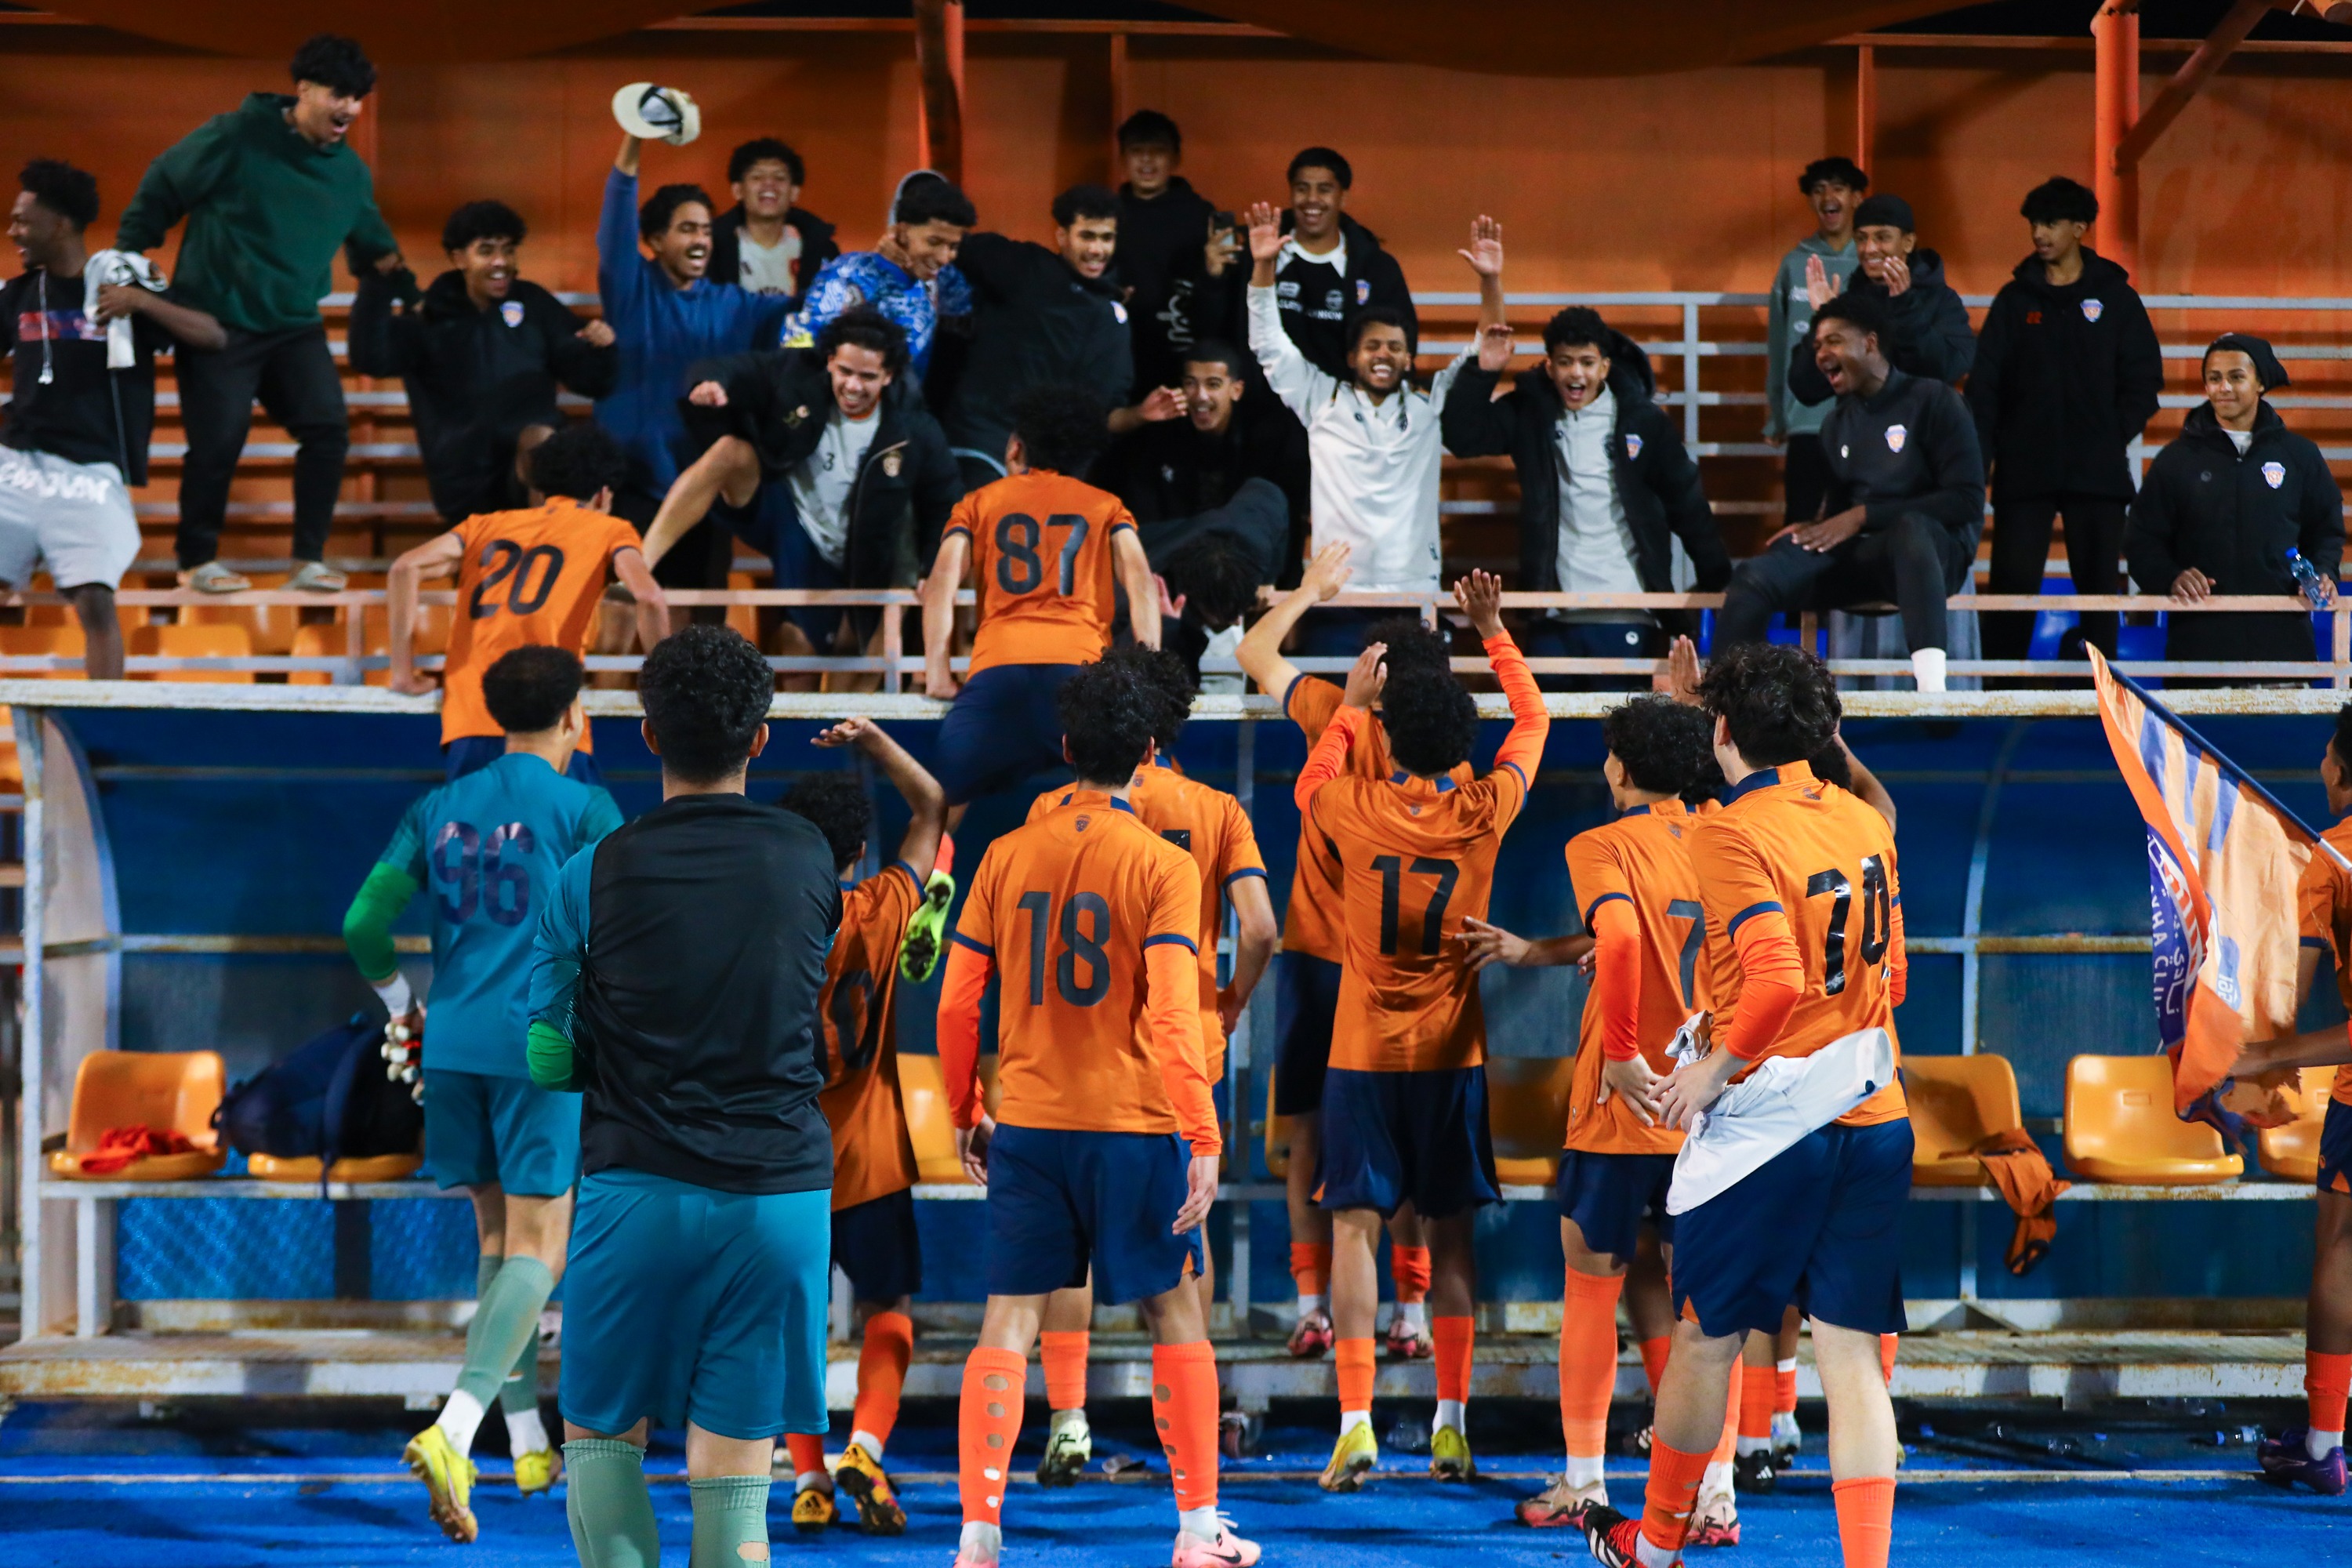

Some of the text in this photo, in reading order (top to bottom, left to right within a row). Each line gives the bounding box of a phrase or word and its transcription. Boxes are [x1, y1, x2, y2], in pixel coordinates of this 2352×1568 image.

[470, 539, 564, 620] 20
[995, 513, 1090, 596] 87
[434, 821, 535, 926] 96
[1370, 855, 1460, 956] 17
[1017, 891, 1111, 1007] 18
